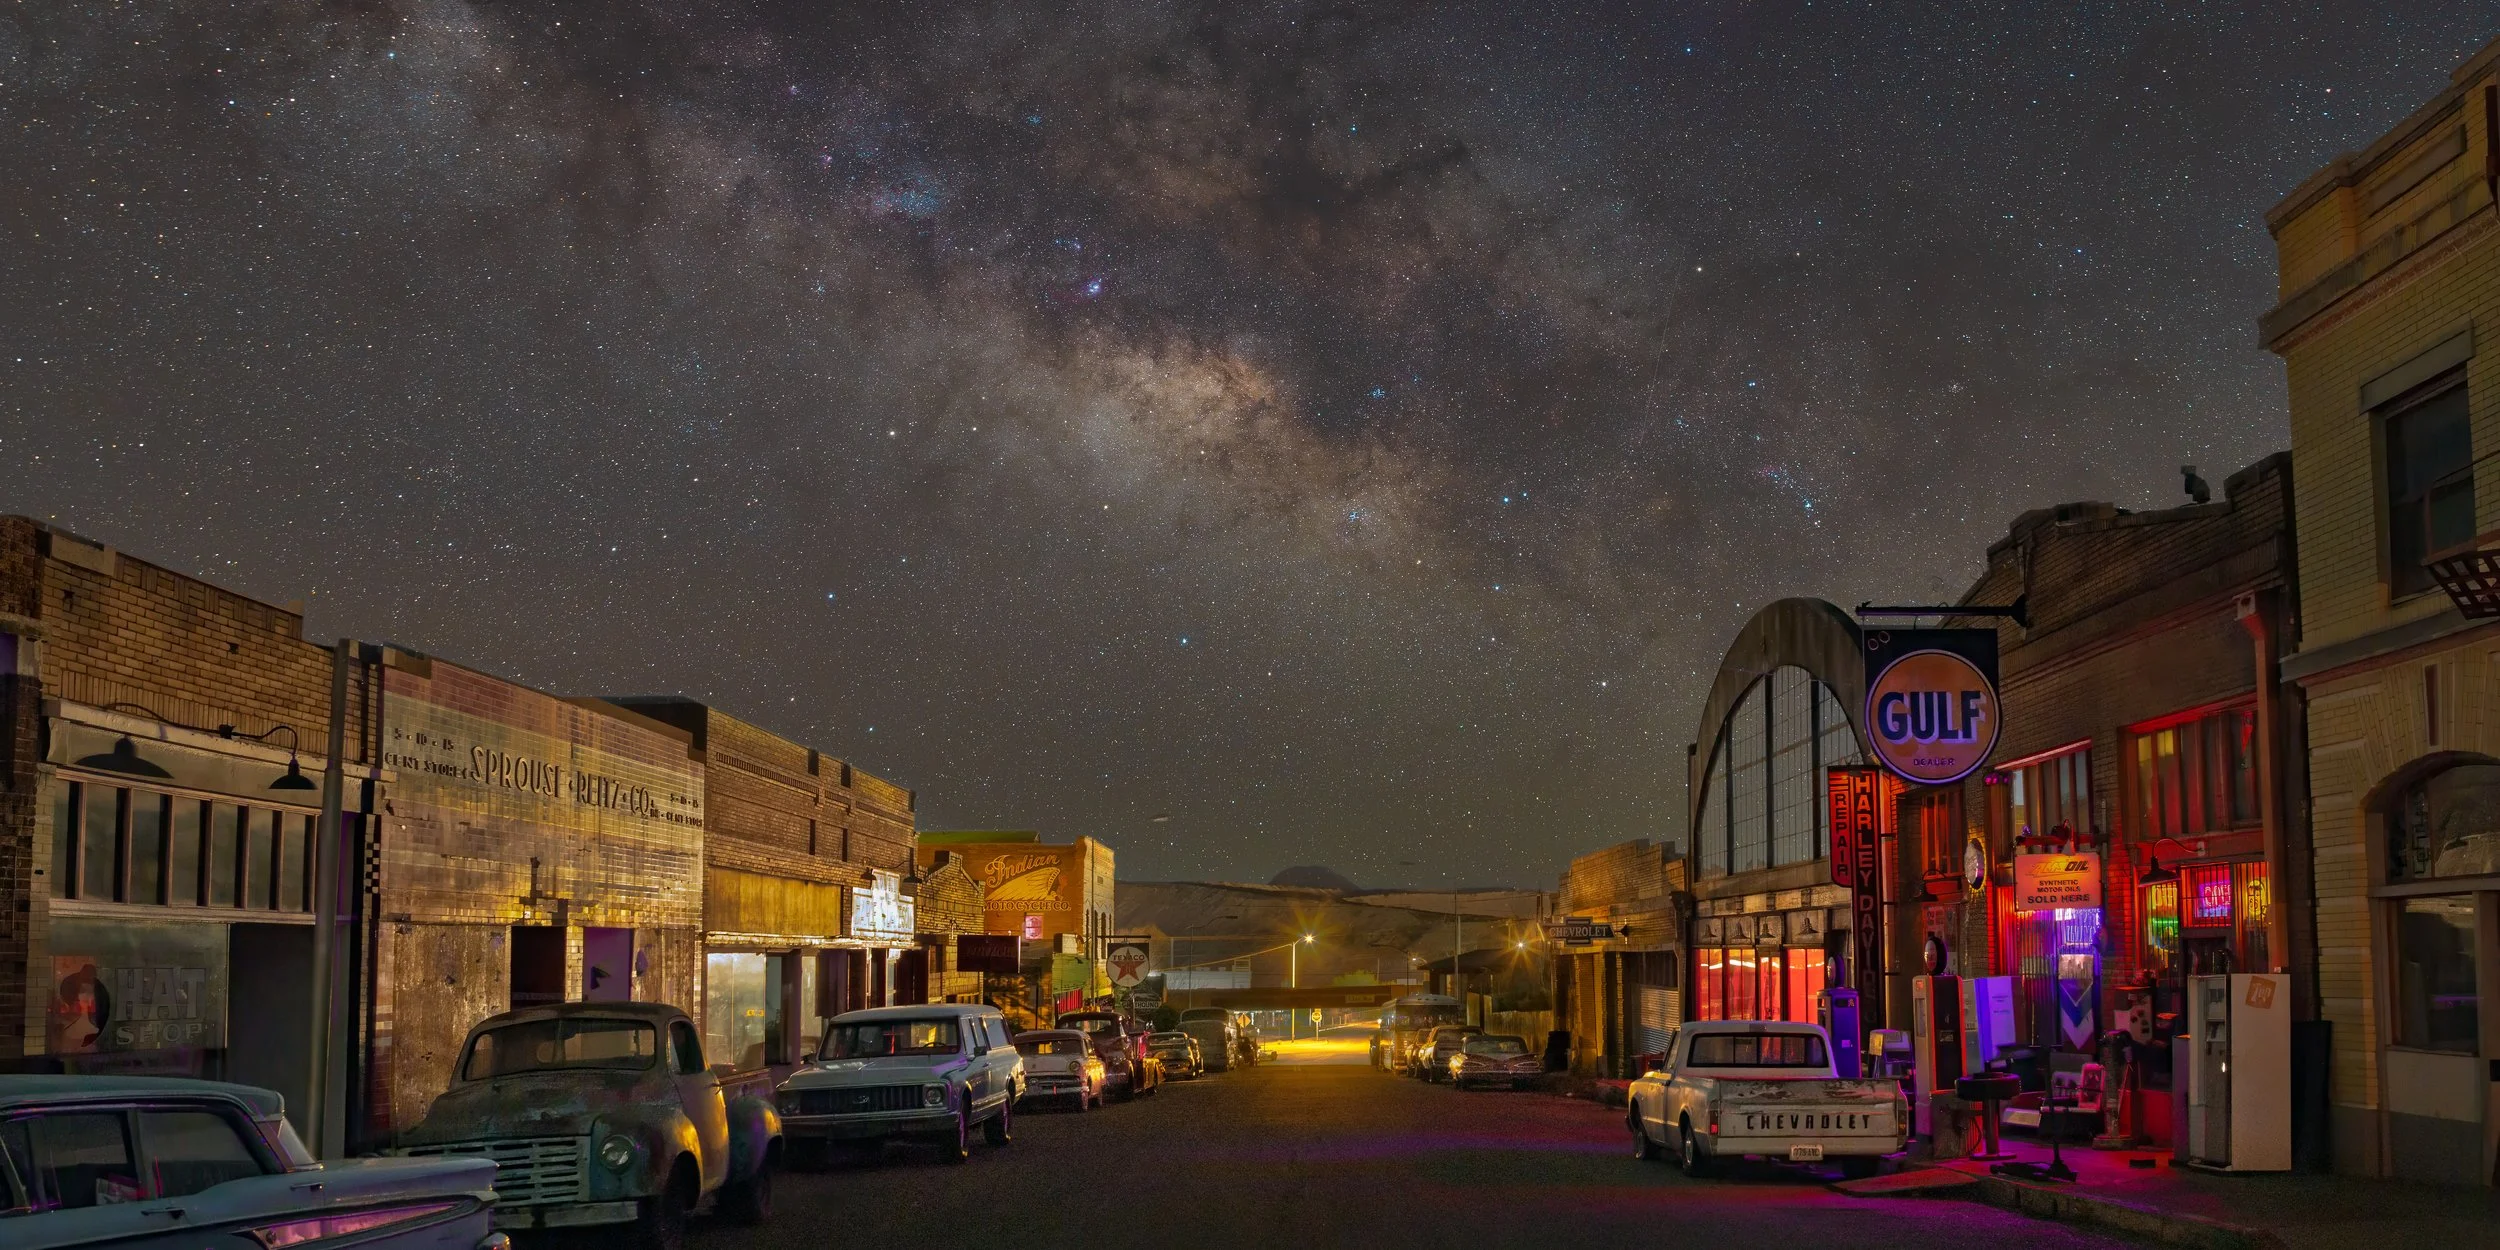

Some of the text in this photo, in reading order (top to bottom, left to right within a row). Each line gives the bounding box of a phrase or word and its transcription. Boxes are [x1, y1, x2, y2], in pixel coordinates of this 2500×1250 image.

[1878, 690, 1986, 744] GULF
[1913, 758, 1954, 767] DEALER
[1835, 794, 1848, 876] REPAIR
[1856, 776, 1873, 887] HARLEY
[985, 855, 1060, 888] Indian
[2027, 894, 2090, 904] SOLD HERE
[1549, 926, 1608, 937] CHEVROLET
[115, 967, 207, 1021] HAT
[116, 1023, 202, 1046] SHOP
[1746, 1114, 1870, 1130] CHEVROLET
